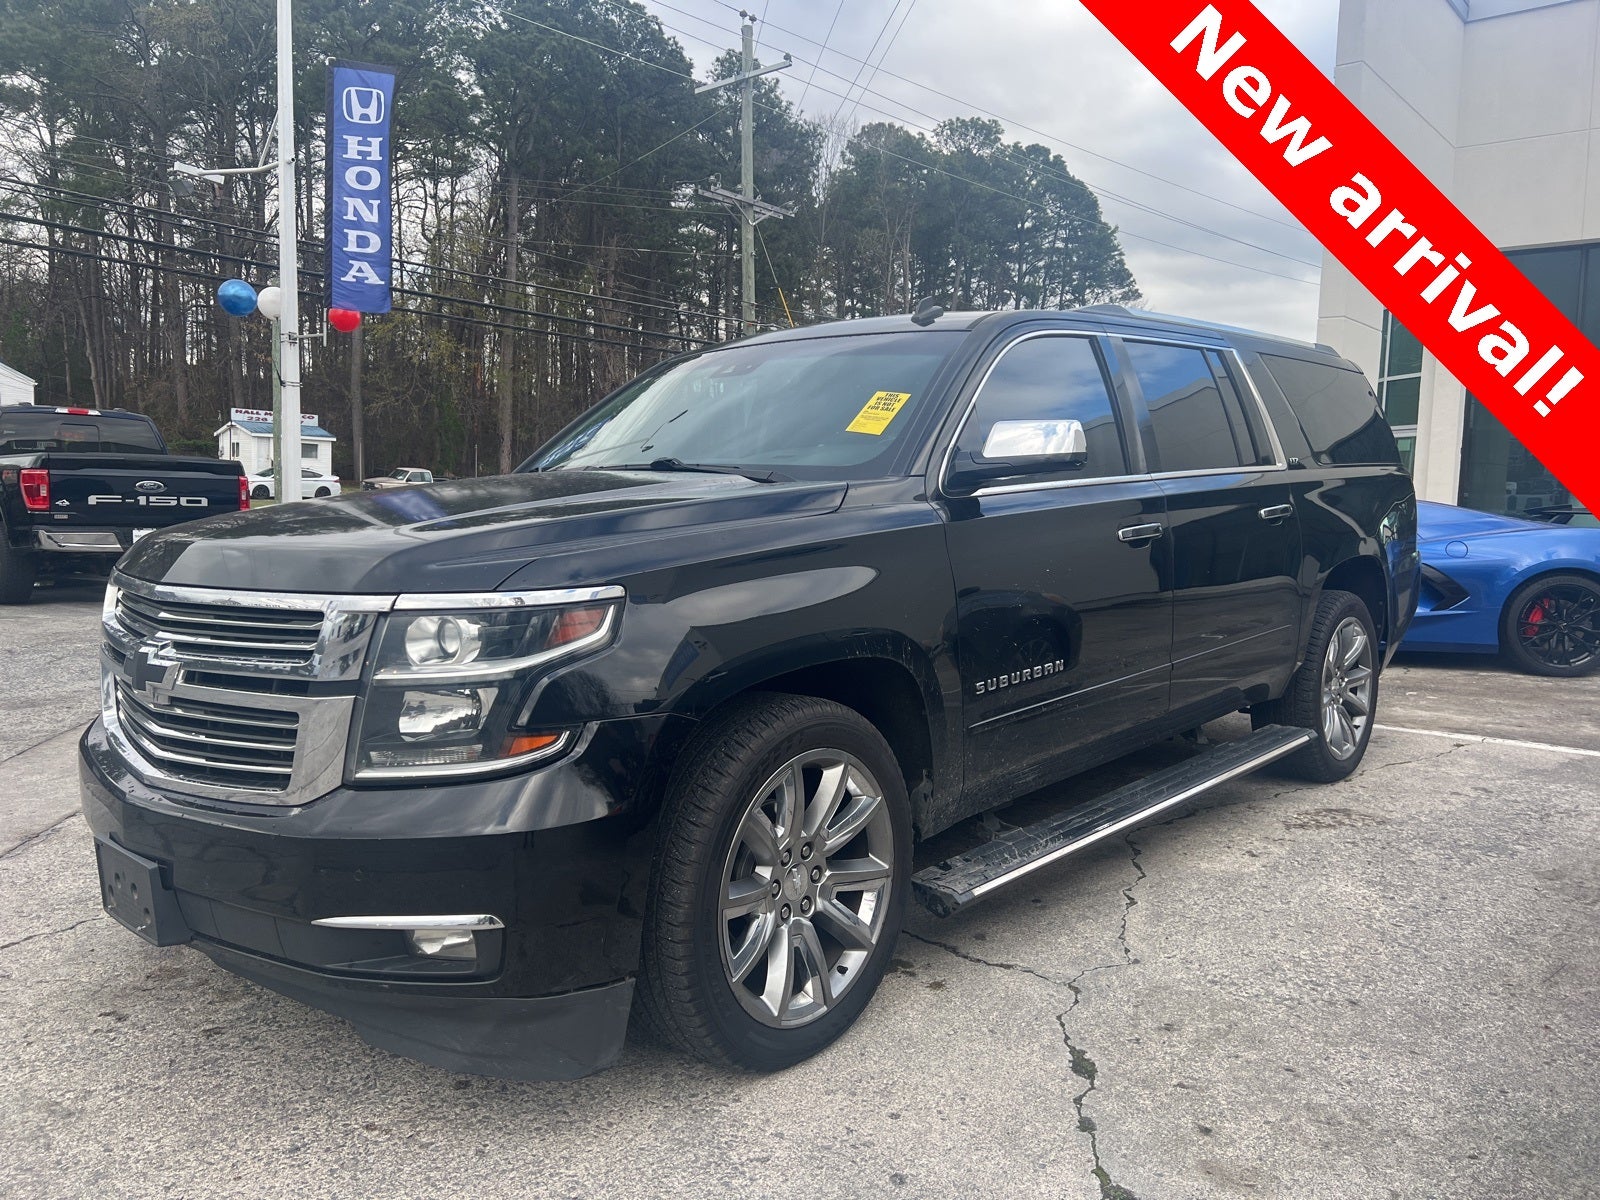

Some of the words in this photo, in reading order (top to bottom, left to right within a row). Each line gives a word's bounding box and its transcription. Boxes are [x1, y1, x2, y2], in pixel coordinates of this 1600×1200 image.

[340, 134, 386, 285] HONDA
[87, 494, 209, 507] F-150
[975, 659, 1064, 695] SUBURBAN
